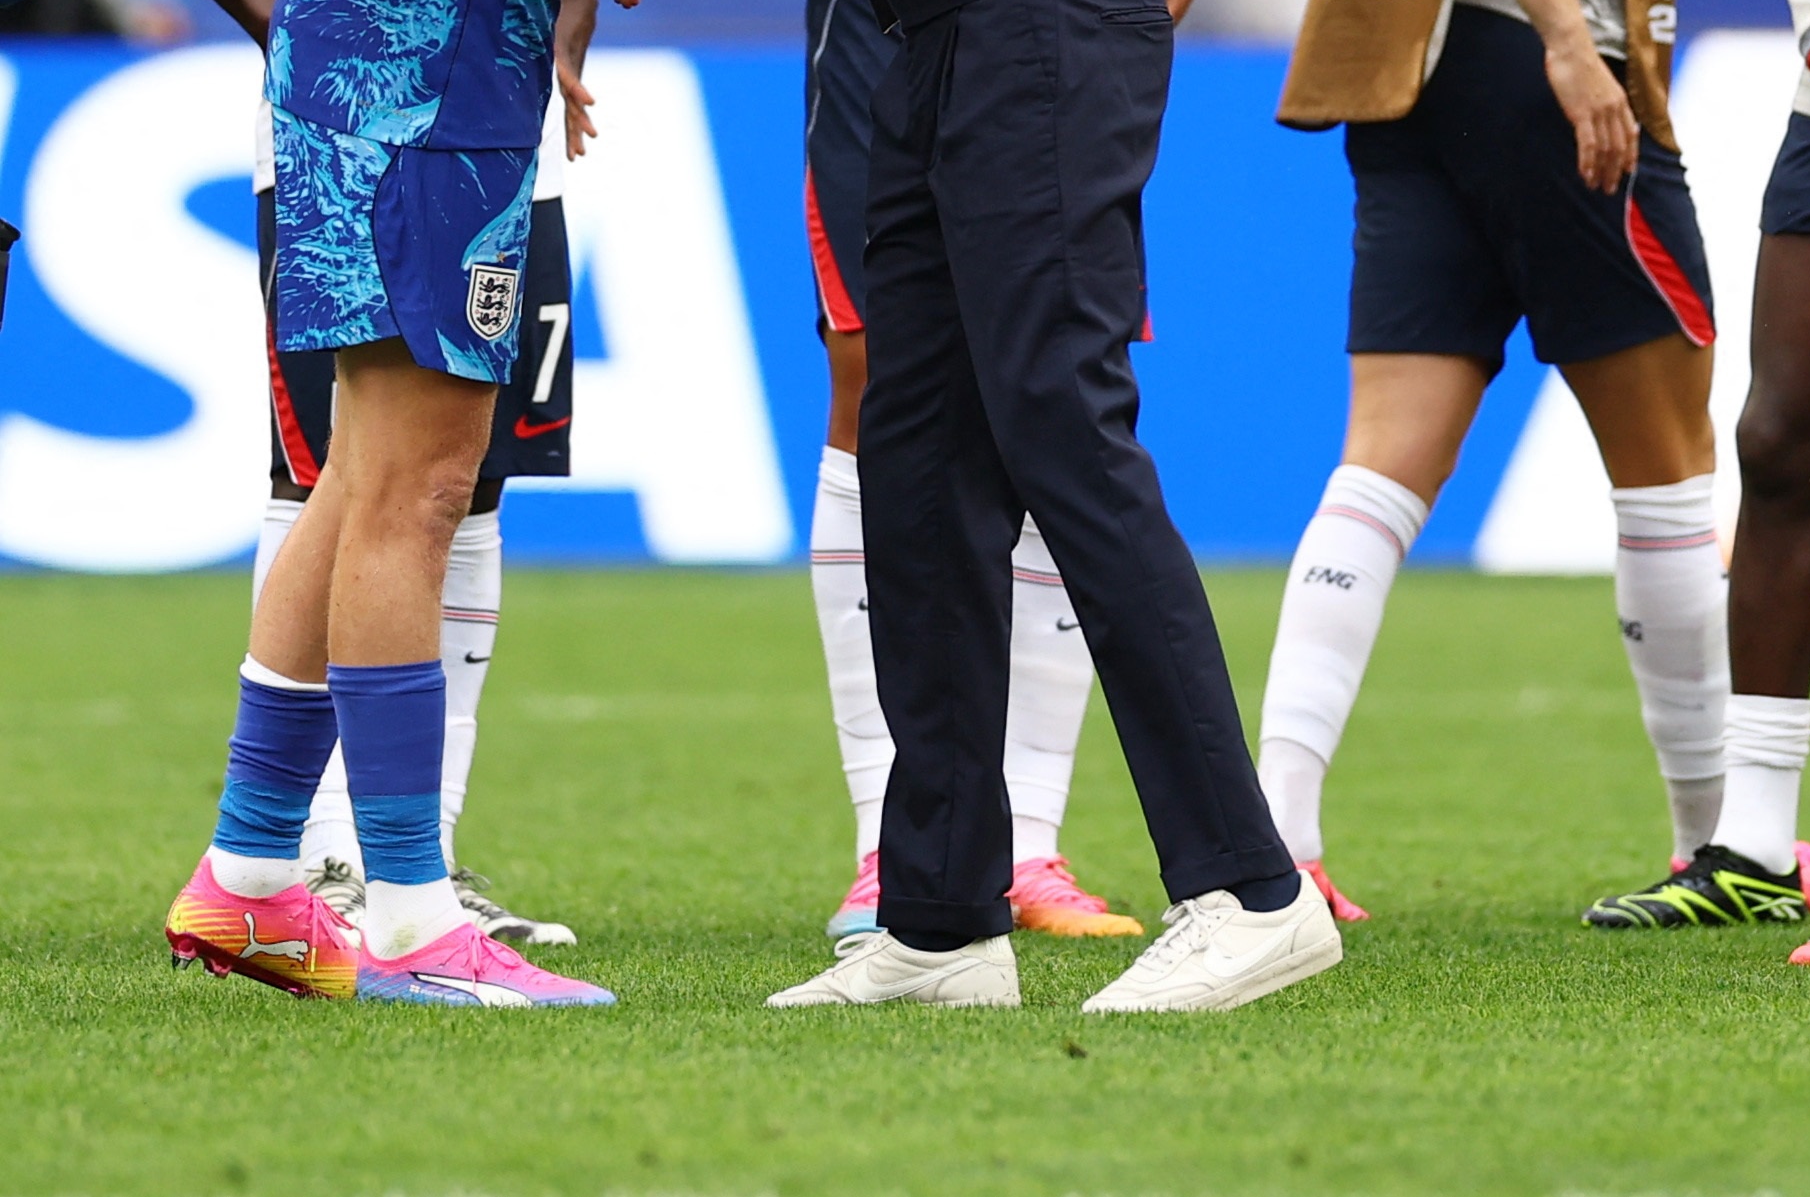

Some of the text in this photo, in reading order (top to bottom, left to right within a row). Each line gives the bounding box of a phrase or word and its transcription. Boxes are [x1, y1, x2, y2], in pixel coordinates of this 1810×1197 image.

[0, 46, 798, 574] SA
[531, 303, 570, 404] 7
[1303, 565, 1358, 591] ENG
